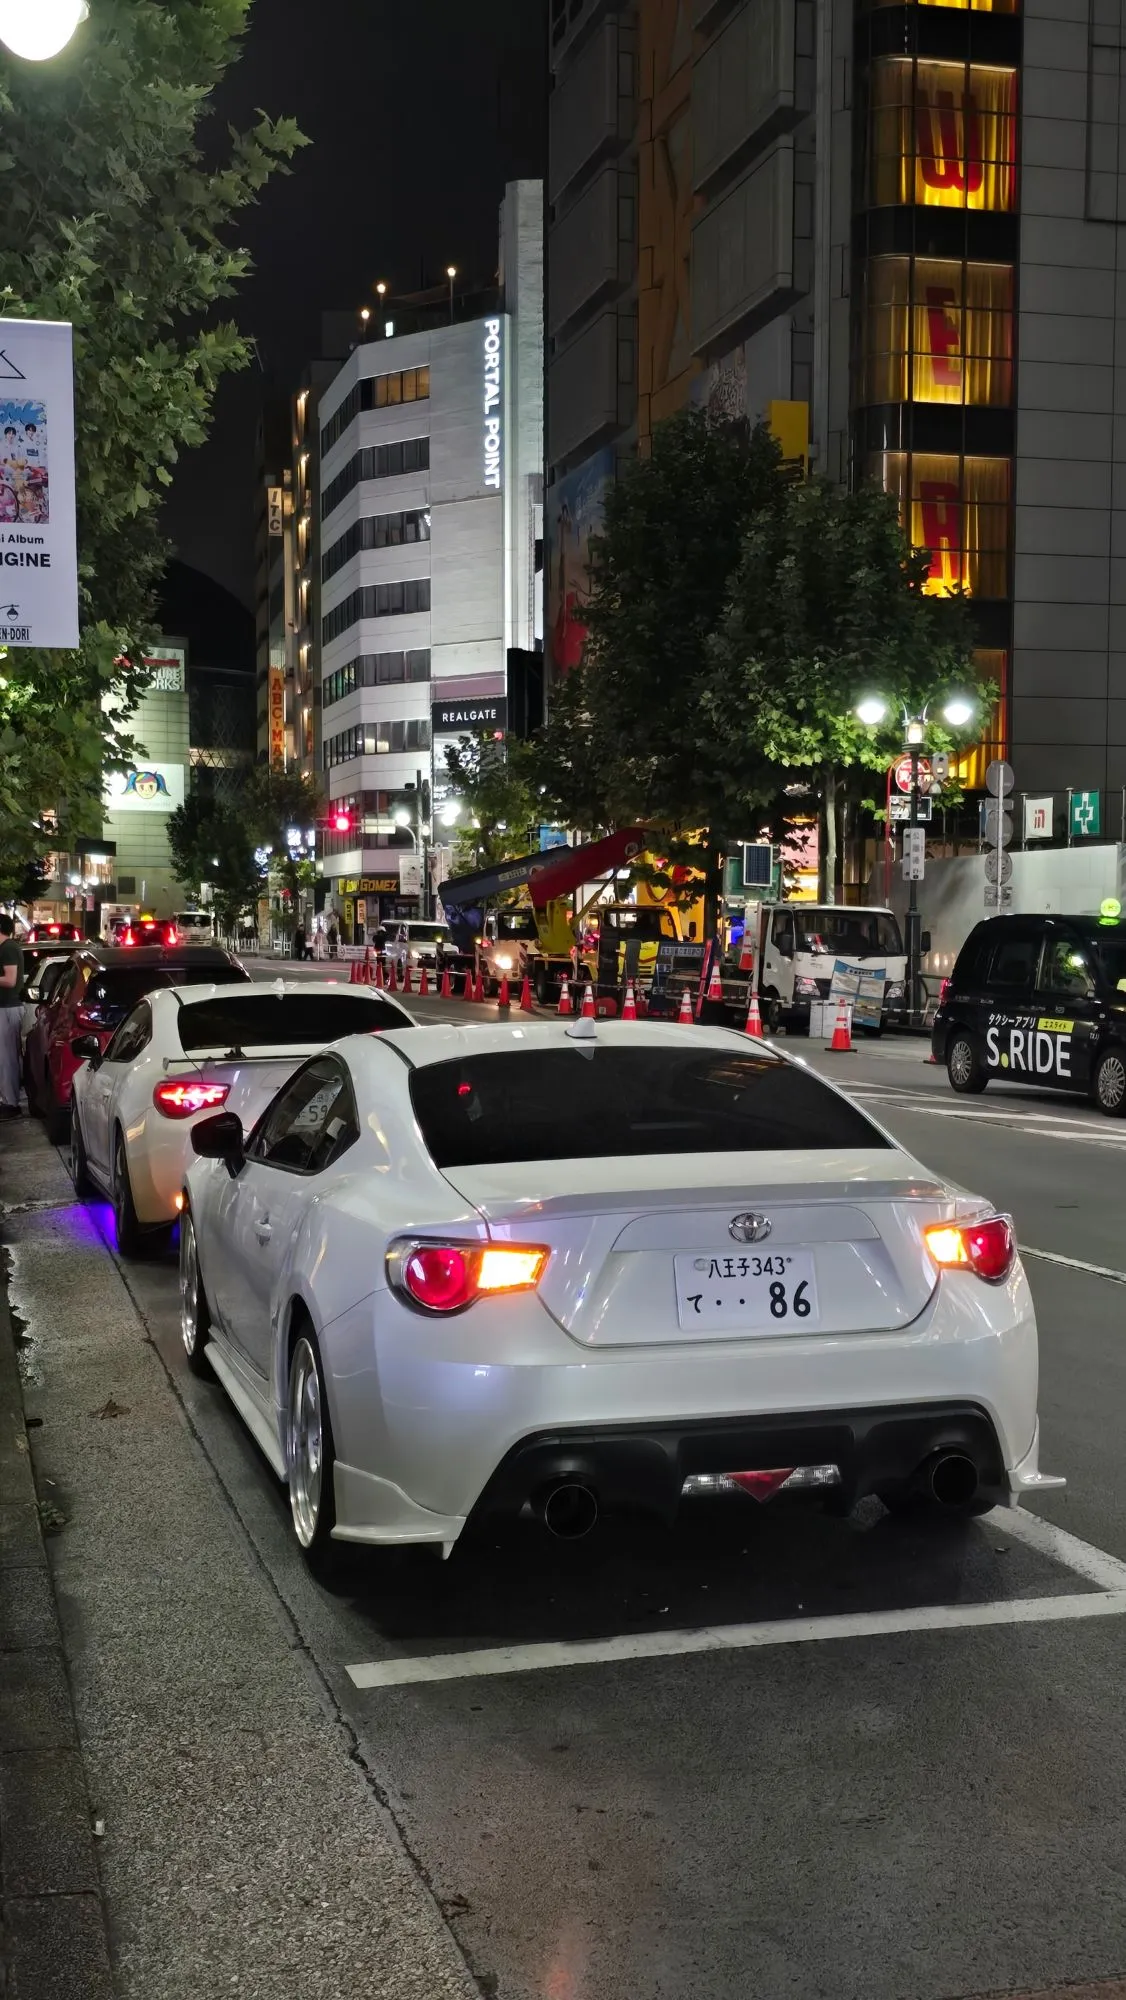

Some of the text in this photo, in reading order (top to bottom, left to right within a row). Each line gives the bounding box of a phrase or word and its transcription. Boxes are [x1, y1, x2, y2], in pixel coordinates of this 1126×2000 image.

[484, 318, 500, 489] PORTAL POINT
[270, 490, 281, 531] ITC
[7, 534, 44, 544] Album
[0, 552, 51, 568] G!NE
[0, 627, 30, 641] N-DORI
[442, 709, 497, 722] REALGATE
[360, 879, 397, 892] GOMEZ
[988, 1013, 1036, 1029] タクシーアプリ
[986, 1026, 1072, 1078] S.RIDE
[769, 1280, 811, 1318] 86
